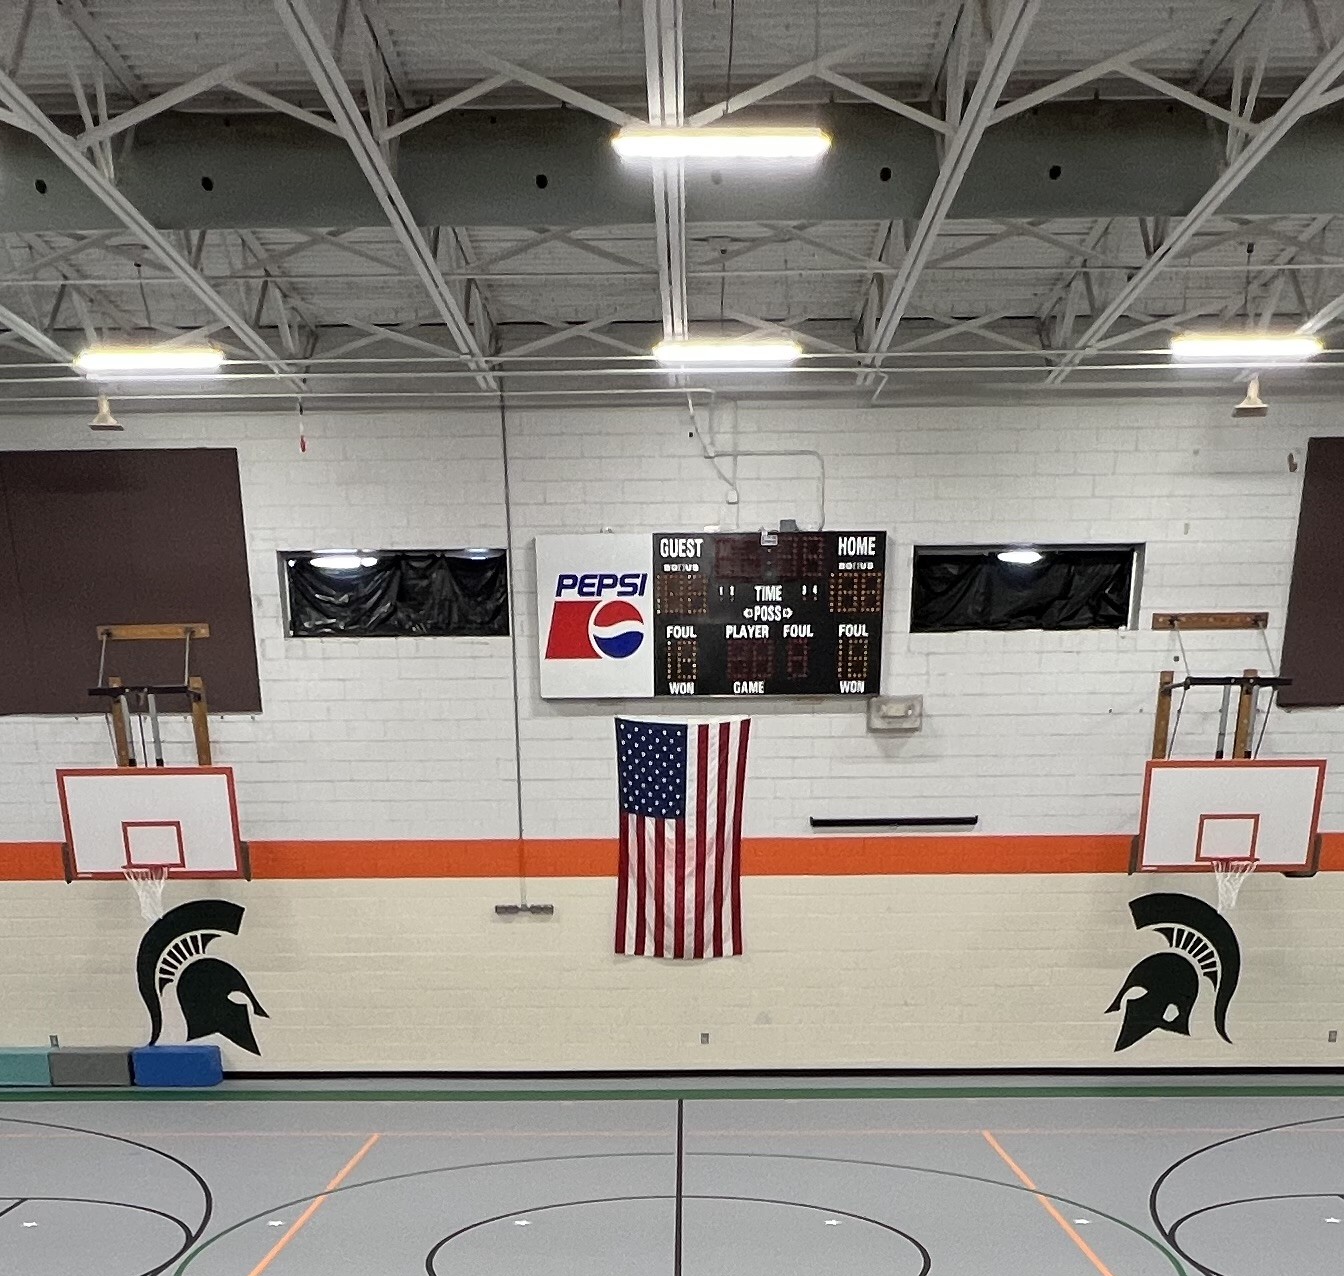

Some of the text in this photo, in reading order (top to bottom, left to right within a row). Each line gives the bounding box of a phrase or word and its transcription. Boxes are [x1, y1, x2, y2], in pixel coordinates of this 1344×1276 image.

[660, 538, 703, 558] GUEST
[837, 536, 876, 556] HOME
[555, 573, 648, 598] PEPSI
[754, 585, 783, 601] TIME
[754, 605, 782, 621] POSS
[666, 625, 697, 639] FOUL
[725, 625, 770, 639] PLAYER
[783, 624, 814, 638] FOUL
[838, 624, 869, 637] FOUL
[668, 682, 695, 695] WON
[733, 681, 765, 694] GAME
[839, 680, 865, 694] WON
